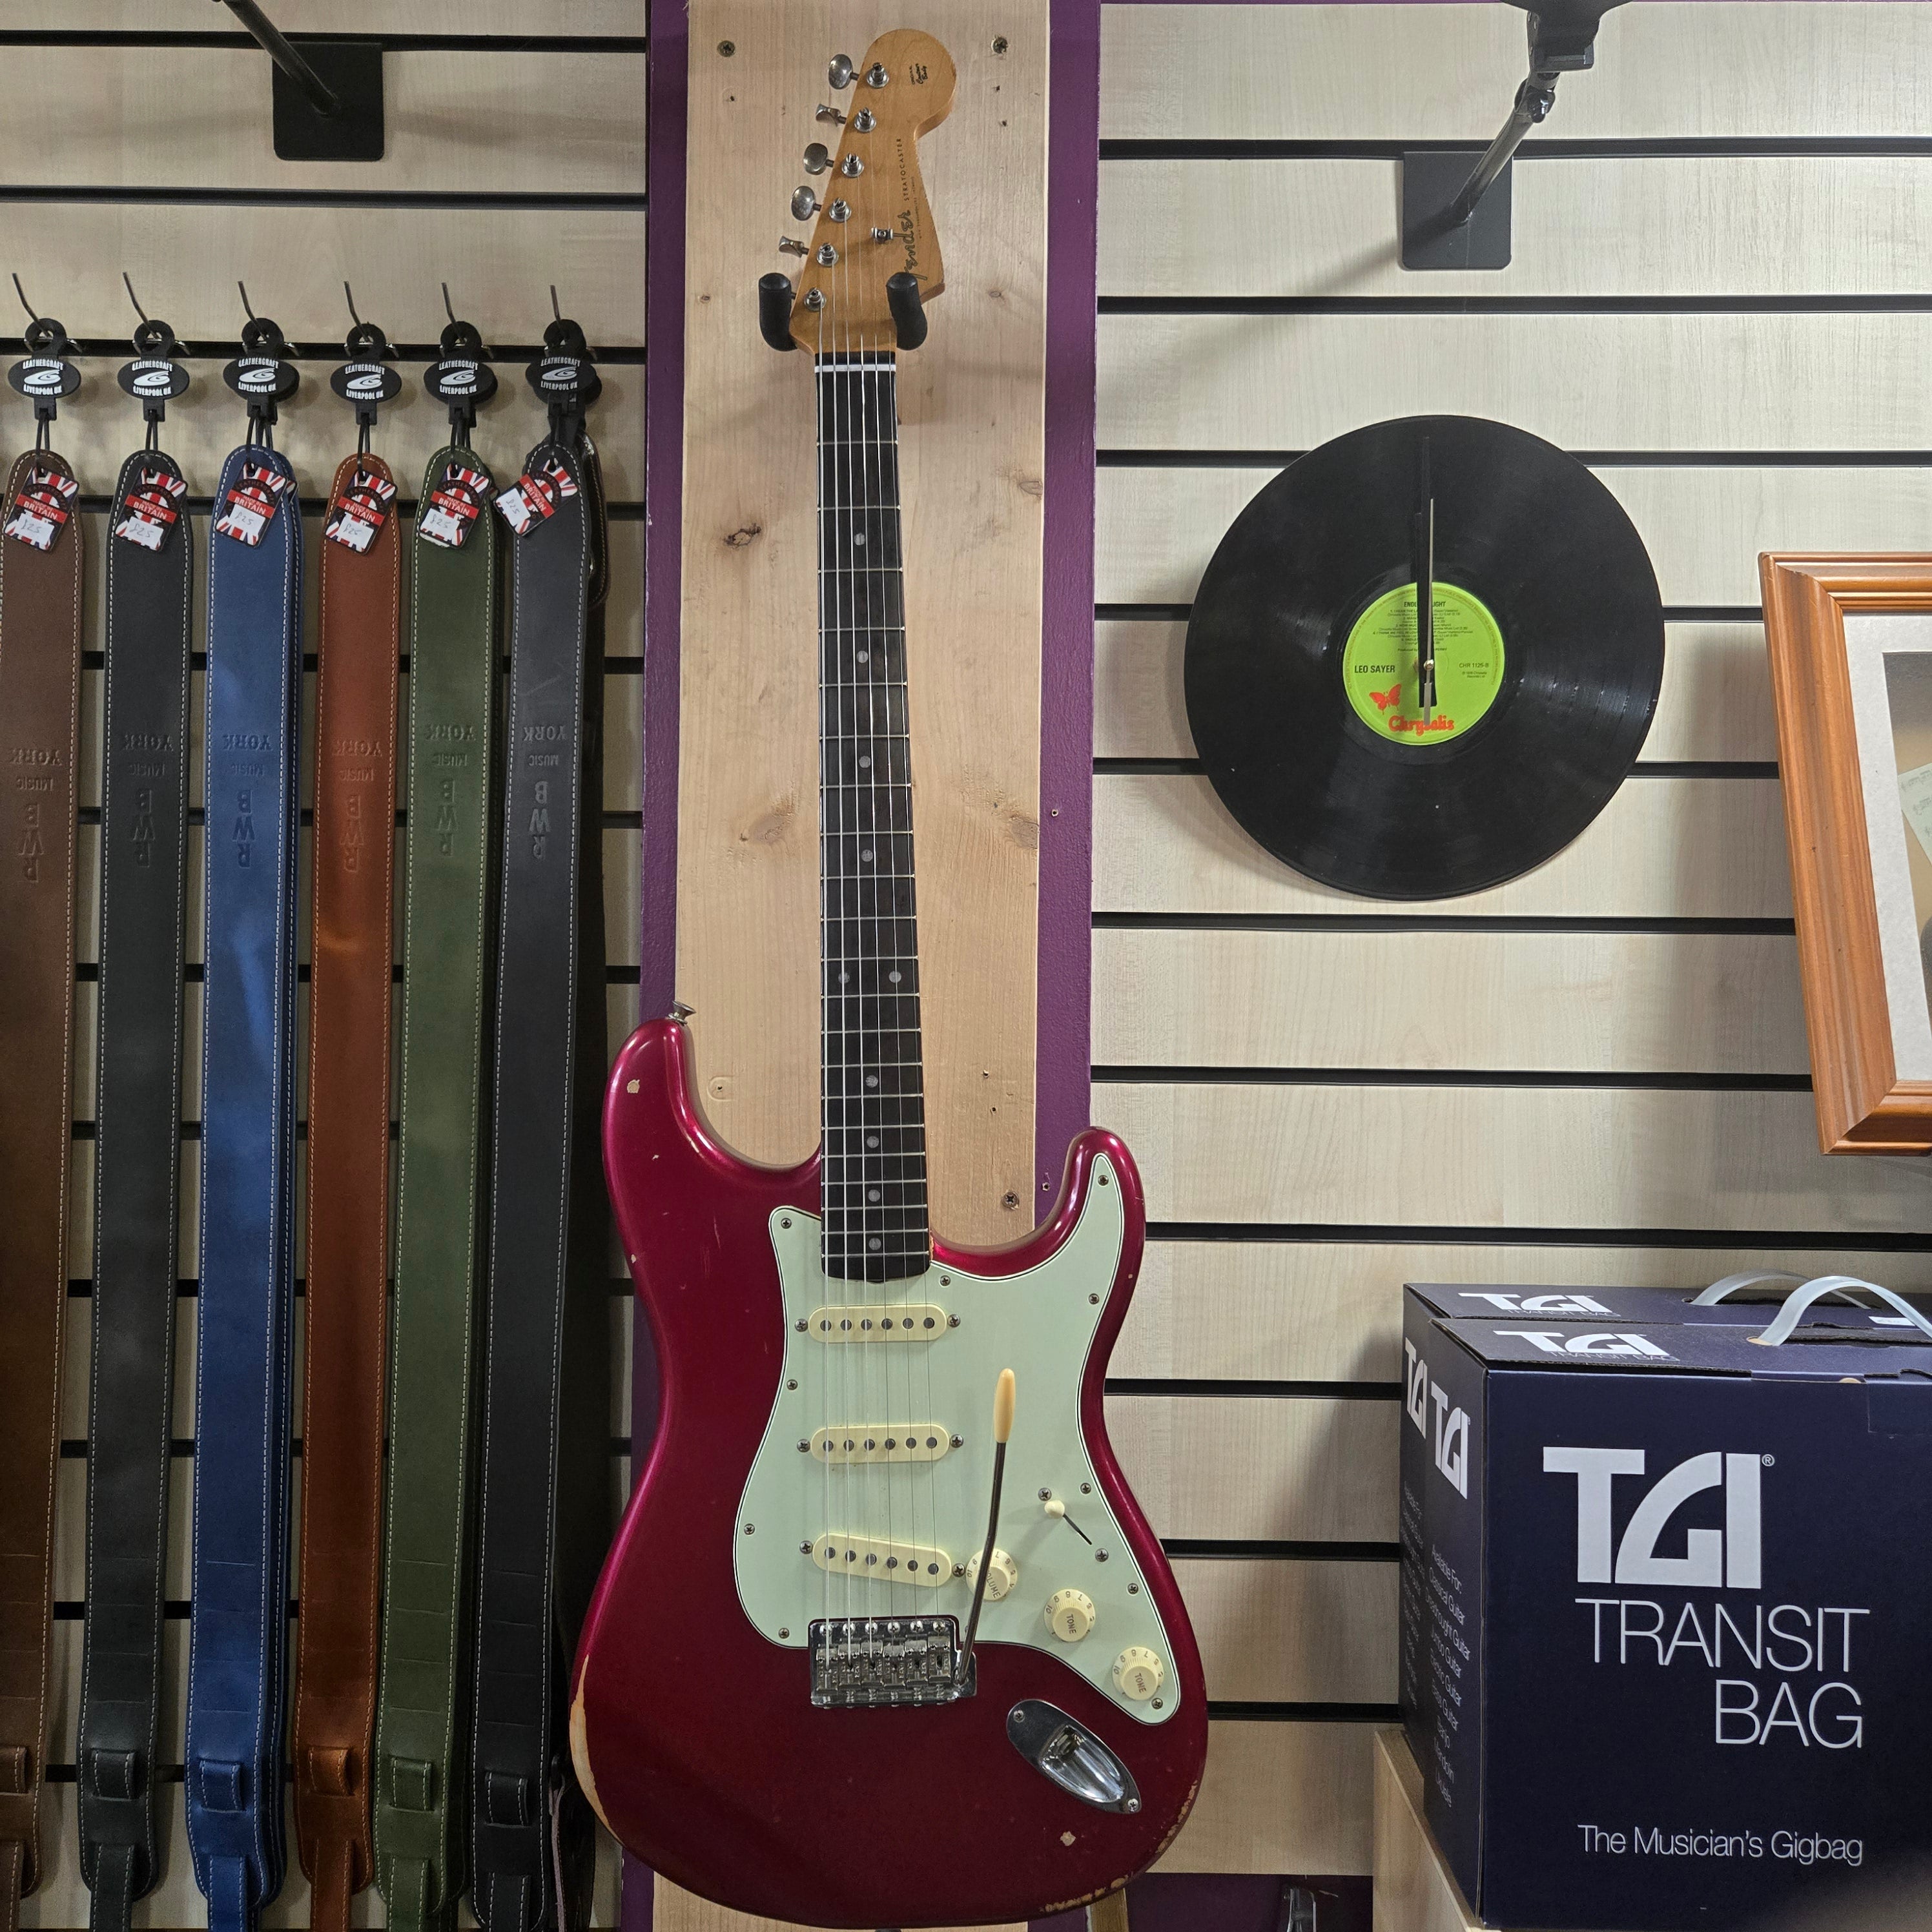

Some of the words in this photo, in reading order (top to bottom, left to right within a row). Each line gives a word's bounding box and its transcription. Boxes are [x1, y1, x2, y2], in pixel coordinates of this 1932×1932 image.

[896, 138, 909, 201] STRATOCASTER
[23, 384, 54, 395] LIVERPOOL
[54, 385, 62, 394] UK
[133, 385, 163, 396] LIVERPOOL
[163, 387, 171, 395] UK
[238, 382, 267, 393] LIVERPOOL
[346, 389, 375, 399] LIVERPOOL
[376, 390, 384, 398] UK
[440, 385, 468, 395] LIVERPOOL
[540, 381, 569, 390] LIVERPOOL
[234, 497, 266, 515] BRITAIN
[524, 483, 546, 511] BRITAIN
[24, 501, 57, 520] BRITAIN
[133, 502, 167, 520] BRITAIN
[344, 504, 375, 522] BRITAIN
[438, 498, 469, 516] BRITAIN
[235, 511, 253, 525] £25
[425, 724, 476, 741] YORK
[523, 726, 567, 742] YORK
[123, 734, 174, 750] YORK
[222, 734, 272, 751] YORK
[332, 740, 383, 757] YORK
[9, 748, 61, 766] YORK
[986, 1571, 1001, 1598] OLUME
[1448, 1594, 1466, 1627] Guitar
[1066, 1614, 1076, 1634] TONE
[1574, 1598, 1871, 1672] TRANSIT
[1452, 1629, 1472, 1661] Guitar
[1444, 1647, 1462, 1679] Guitar
[1135, 1672, 1147, 1694] TONE
[1444, 1674, 1462, 1707] Guitar
[1442, 1698, 1459, 1732] Guitar
[1715, 1680, 1862, 1749] BAG
[1577, 1824, 1626, 1853] The
[1634, 1826, 1763, 1858] Musician's
[1771, 1830, 1864, 1867] Gigbag
